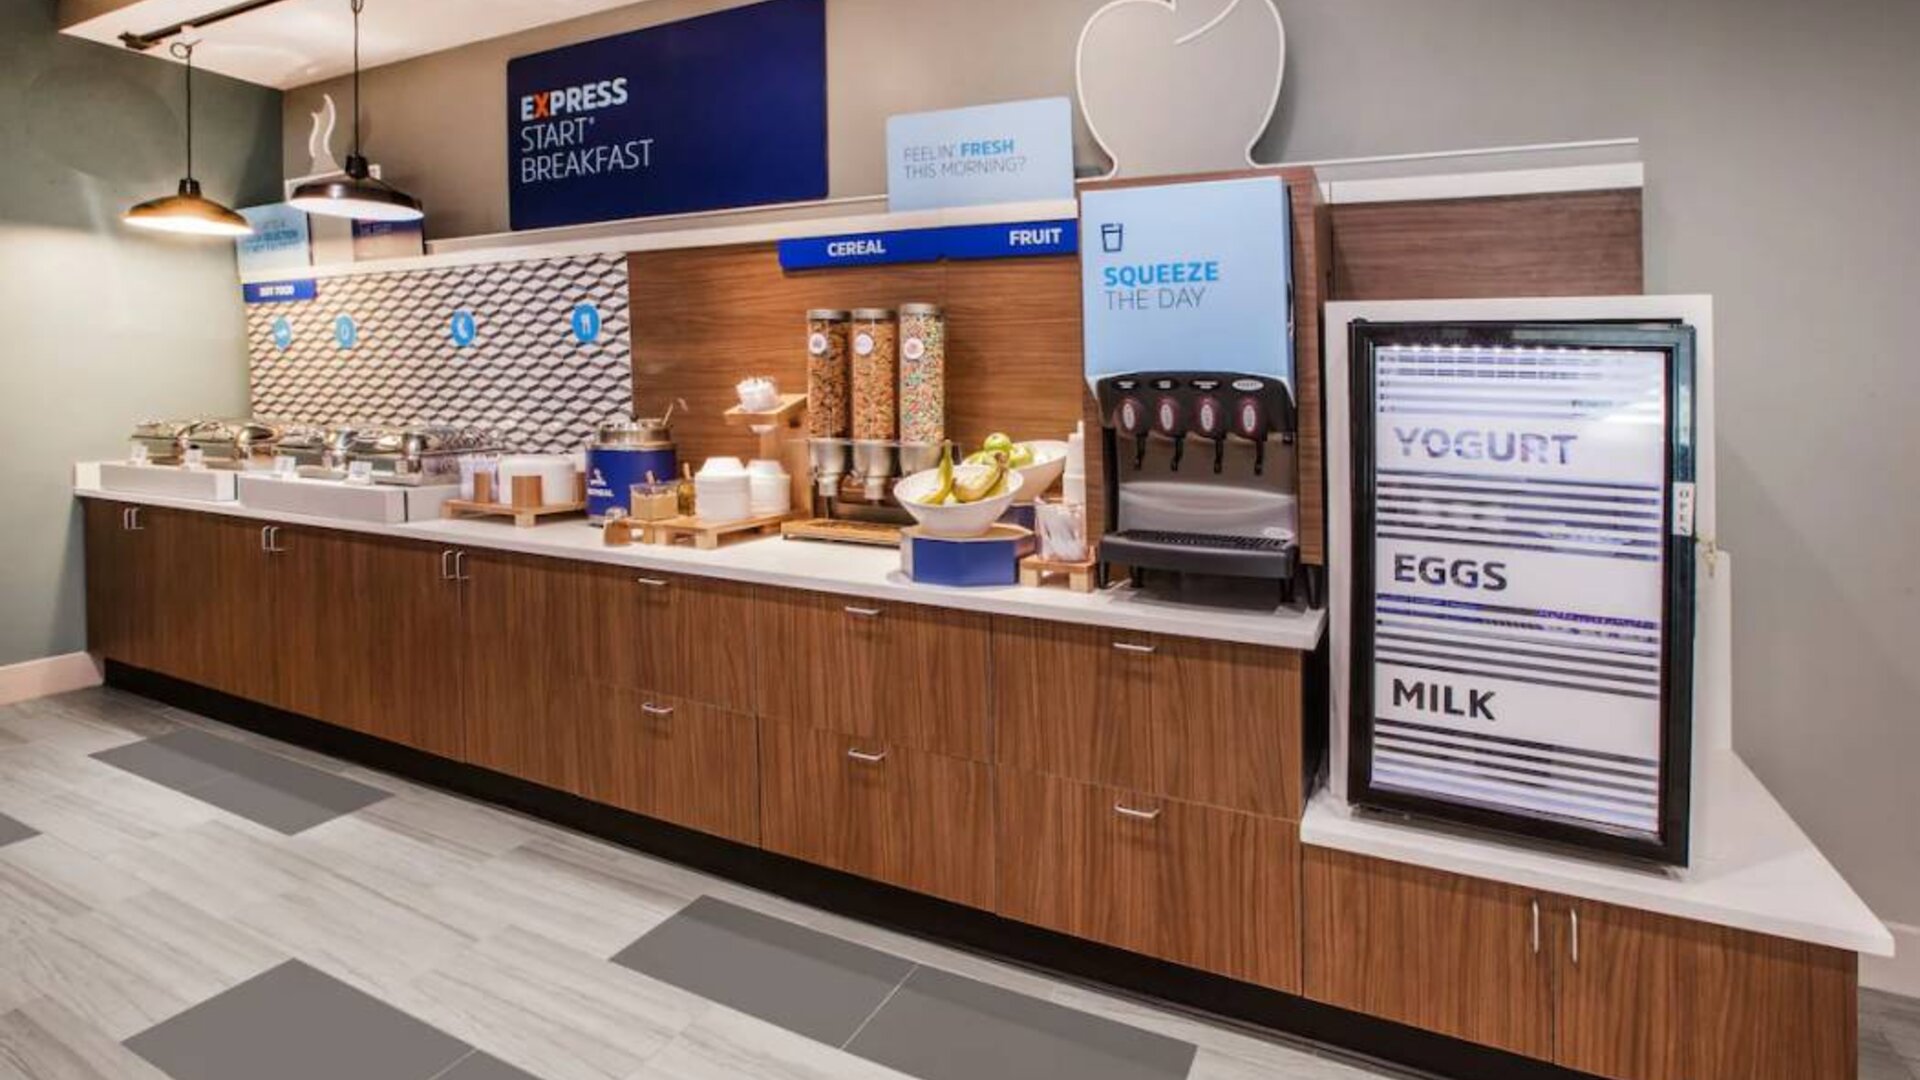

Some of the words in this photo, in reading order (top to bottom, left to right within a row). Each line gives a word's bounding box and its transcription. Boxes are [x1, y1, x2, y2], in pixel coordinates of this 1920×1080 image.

[521, 77, 628, 121] EXPRESS
[521, 139, 653, 183] BREAKFAST
[960, 139, 1014, 158] FRESH
[904, 162, 937, 179] THIS
[941, 156, 1026, 176] MORNING?
[827, 239, 886, 257] CEREAL
[1009, 228, 1063, 246] FRUIT
[1104, 261, 1220, 287] SQUEEZE
[1105, 288, 1148, 310] THE
[1158, 287, 1206, 310] DAY
[1395, 427, 1578, 465] YOGURT
[1393, 553, 1507, 592] EGGS
[1392, 677, 1496, 721] MILK
